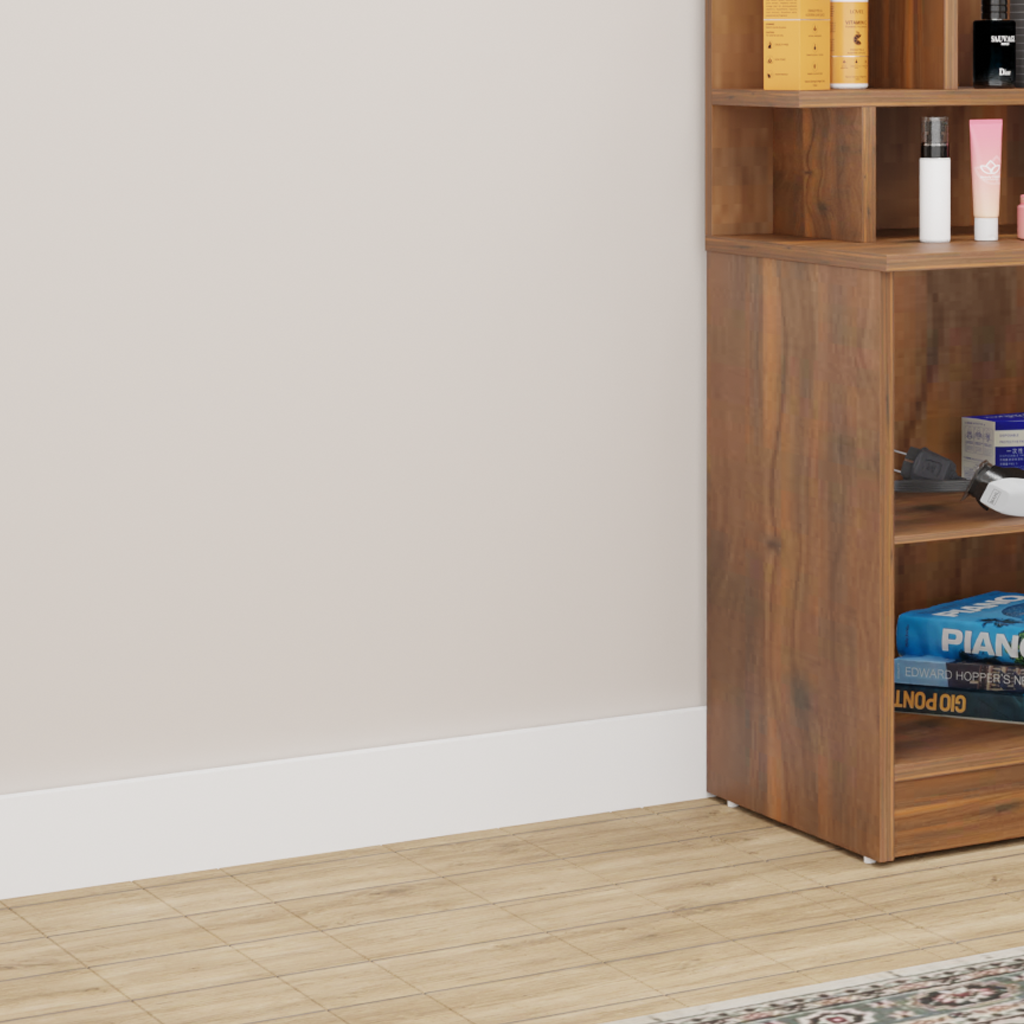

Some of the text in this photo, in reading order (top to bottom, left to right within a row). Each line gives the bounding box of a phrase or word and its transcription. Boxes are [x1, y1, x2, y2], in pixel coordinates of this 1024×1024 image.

[999, 67, 1012, 76] Dior
[905, 666, 952, 680] EDWARD
[955, 671, 1010, 685] HOPPER'S
[939, 693, 967, 713] GIO
